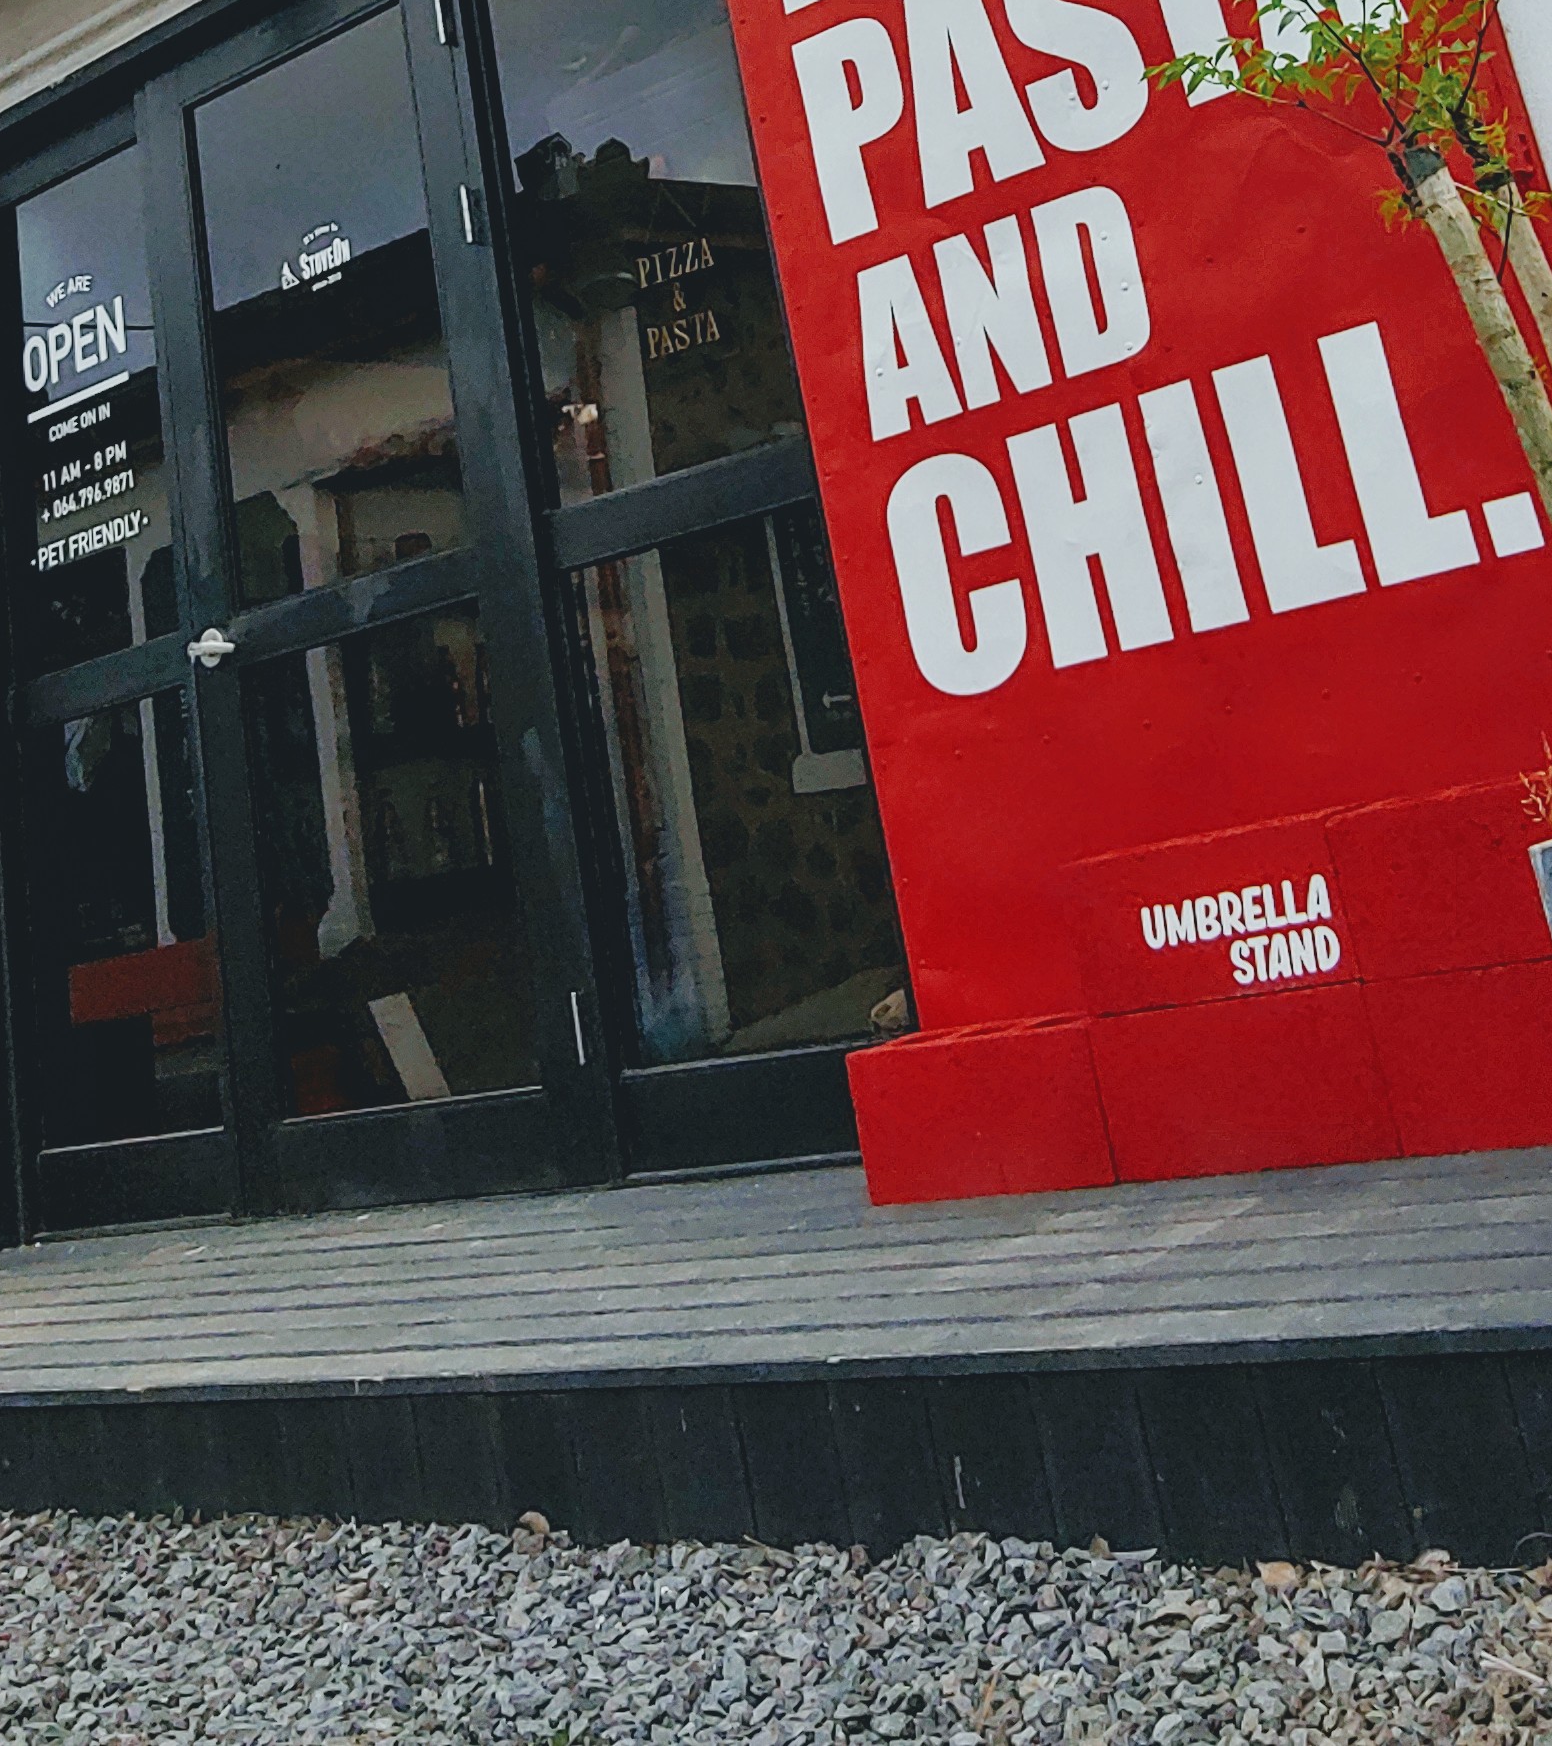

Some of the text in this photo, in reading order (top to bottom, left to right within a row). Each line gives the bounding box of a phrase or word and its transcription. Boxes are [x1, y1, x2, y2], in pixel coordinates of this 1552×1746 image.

[635, 237, 715, 289] PIZZA
[46, 275, 93, 308] WE ARE
[673, 282, 687, 312] &
[856, 185, 1152, 441] AND
[22, 295, 127, 393] OPEN
[646, 309, 721, 359] PASTA
[49, 402, 111, 442] COME ON IN
[42, 470, 57, 492] 11
[60, 460, 82, 485] AM
[93, 451, 103, 471] 8
[105, 440, 127, 466] PM
[886, 321, 1545, 696] CHILL.
[1140, 873, 1332, 950] UMBRELLA
[1229, 925, 1341, 985] STAND
